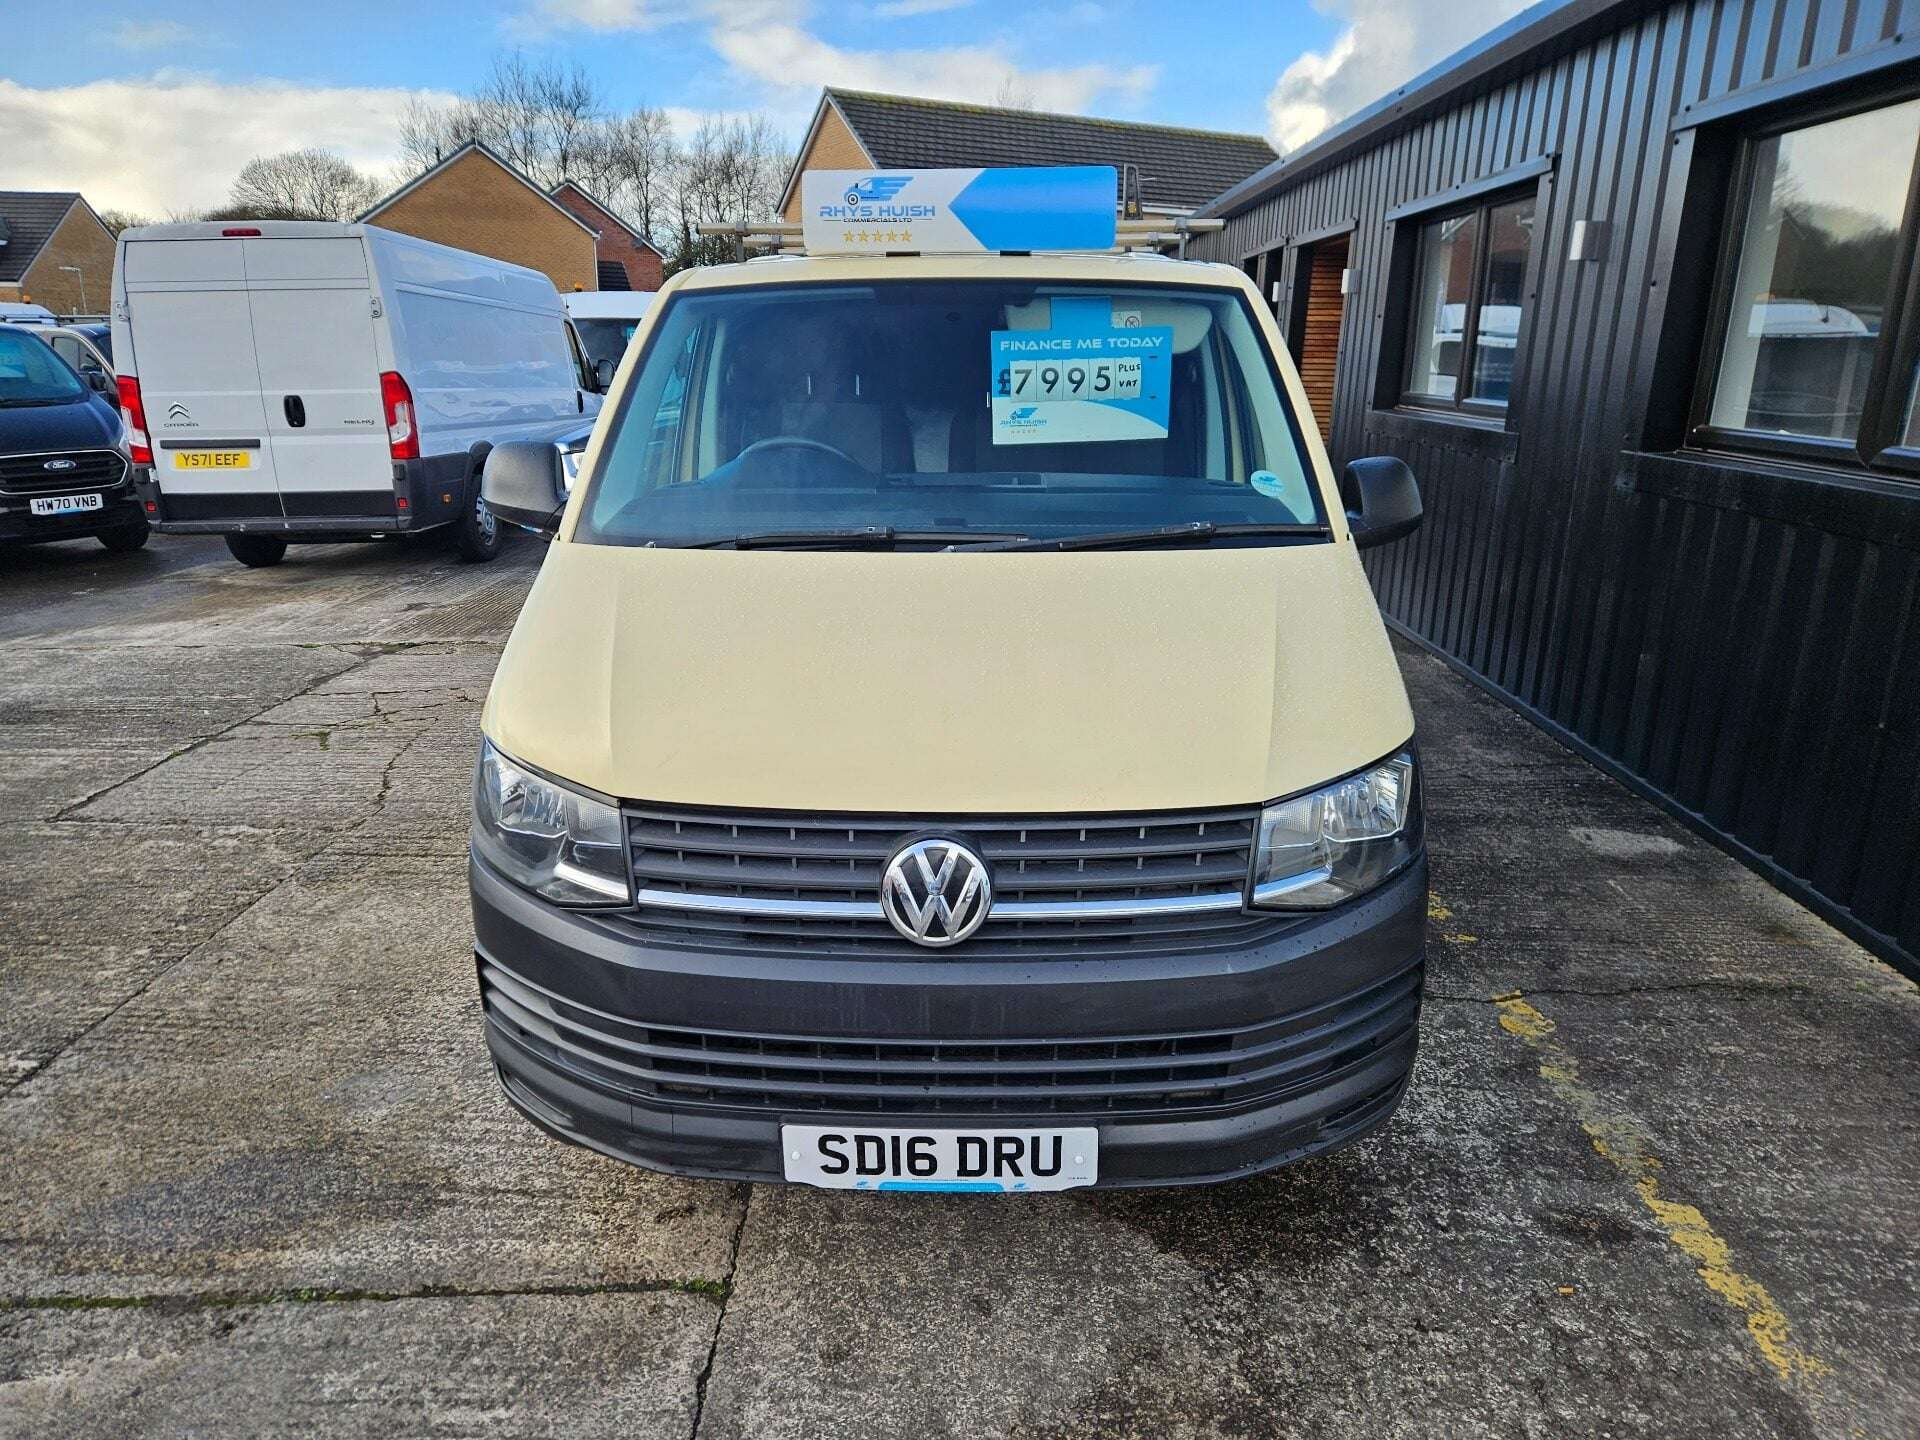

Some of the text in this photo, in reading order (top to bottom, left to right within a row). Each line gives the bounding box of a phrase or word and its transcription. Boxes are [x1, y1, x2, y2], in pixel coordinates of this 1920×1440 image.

[819, 204, 936, 217] RHYS HUISH
[999, 335, 1165, 352] FINANCE ME TODAY
[1117, 362, 1141, 373] PLUS
[1119, 379, 1139, 389] VAT
[182, 453, 240, 466] YS71 EEF
[36, 495, 97, 511] HW70 VNB
[817, 1134, 1063, 1177] SD16 DRU
